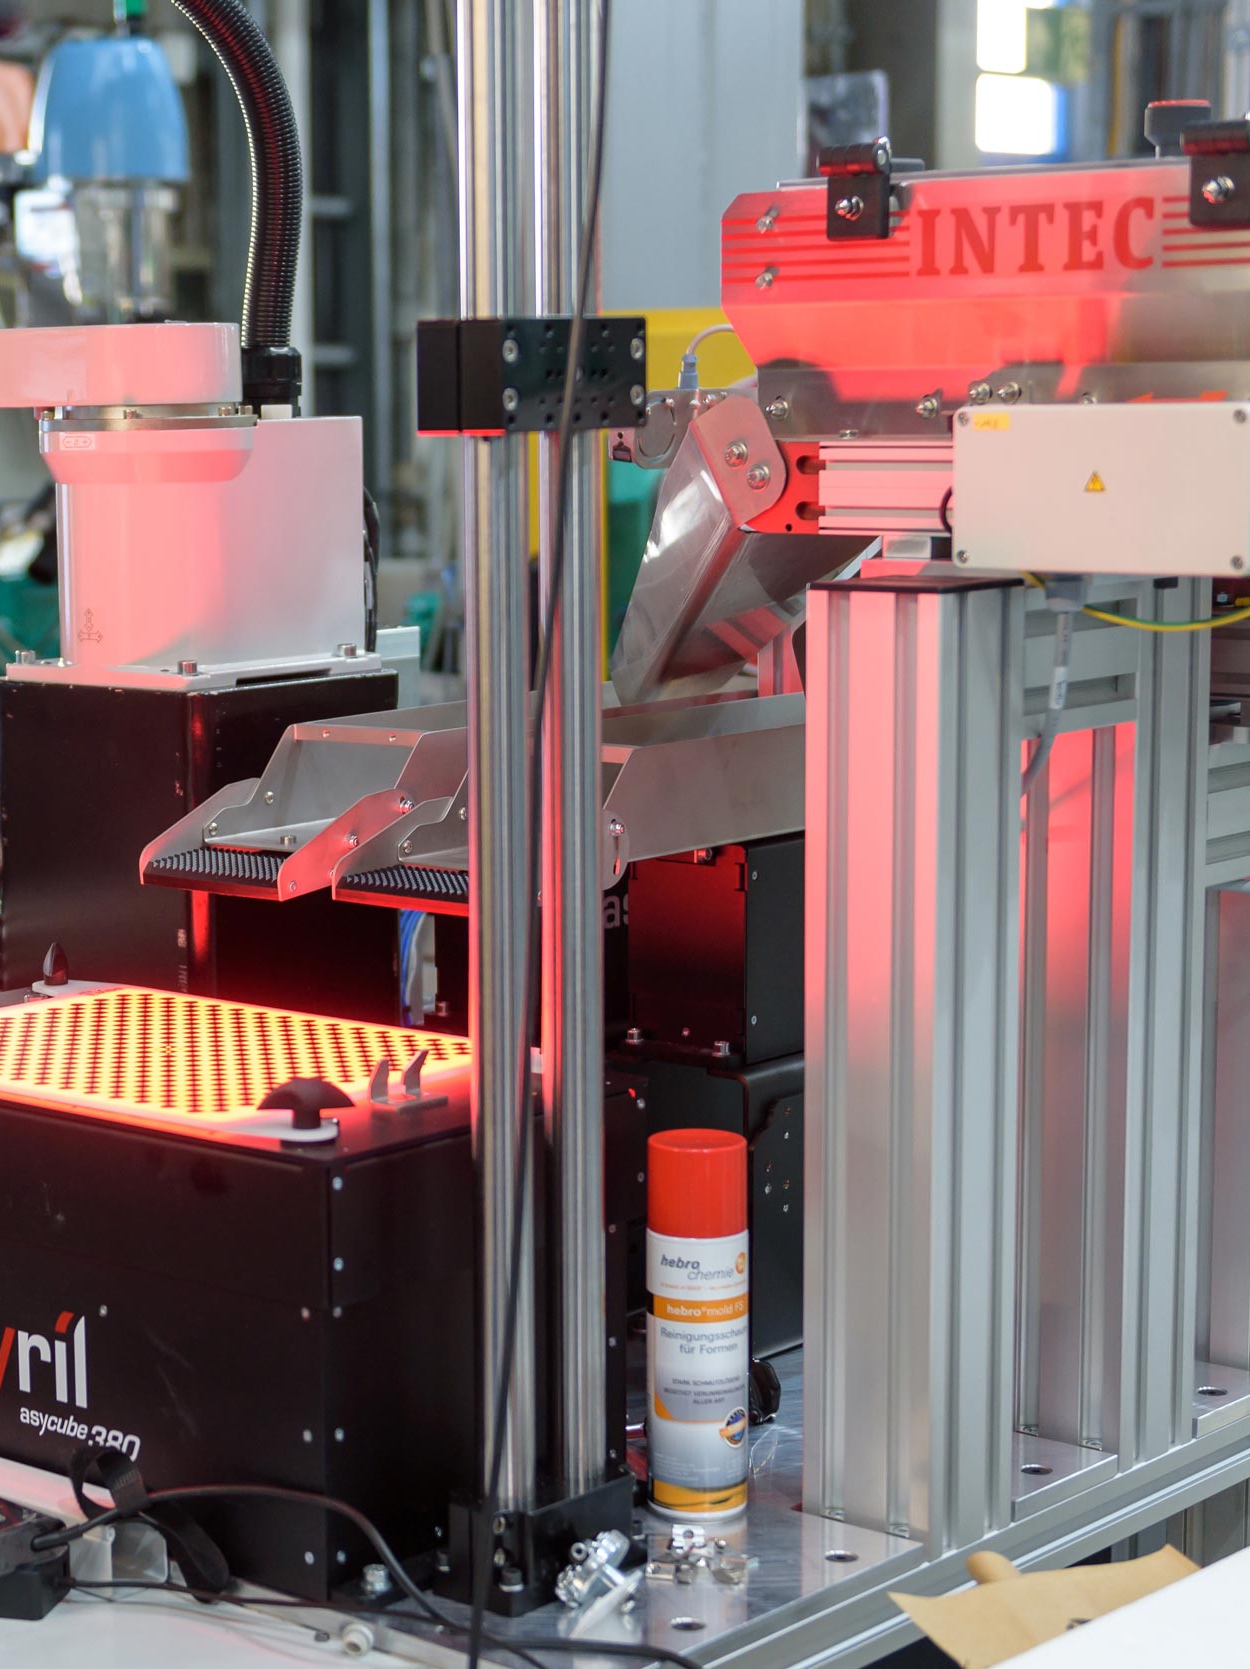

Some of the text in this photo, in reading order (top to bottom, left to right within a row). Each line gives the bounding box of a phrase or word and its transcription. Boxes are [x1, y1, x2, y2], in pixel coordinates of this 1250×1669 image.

[916, 197, 1155, 276] INTEC
[661, 1254, 700, 1270] hebro
[680, 1343, 738, 1354] für Formen
[20, 1407, 88, 1440] asycube
